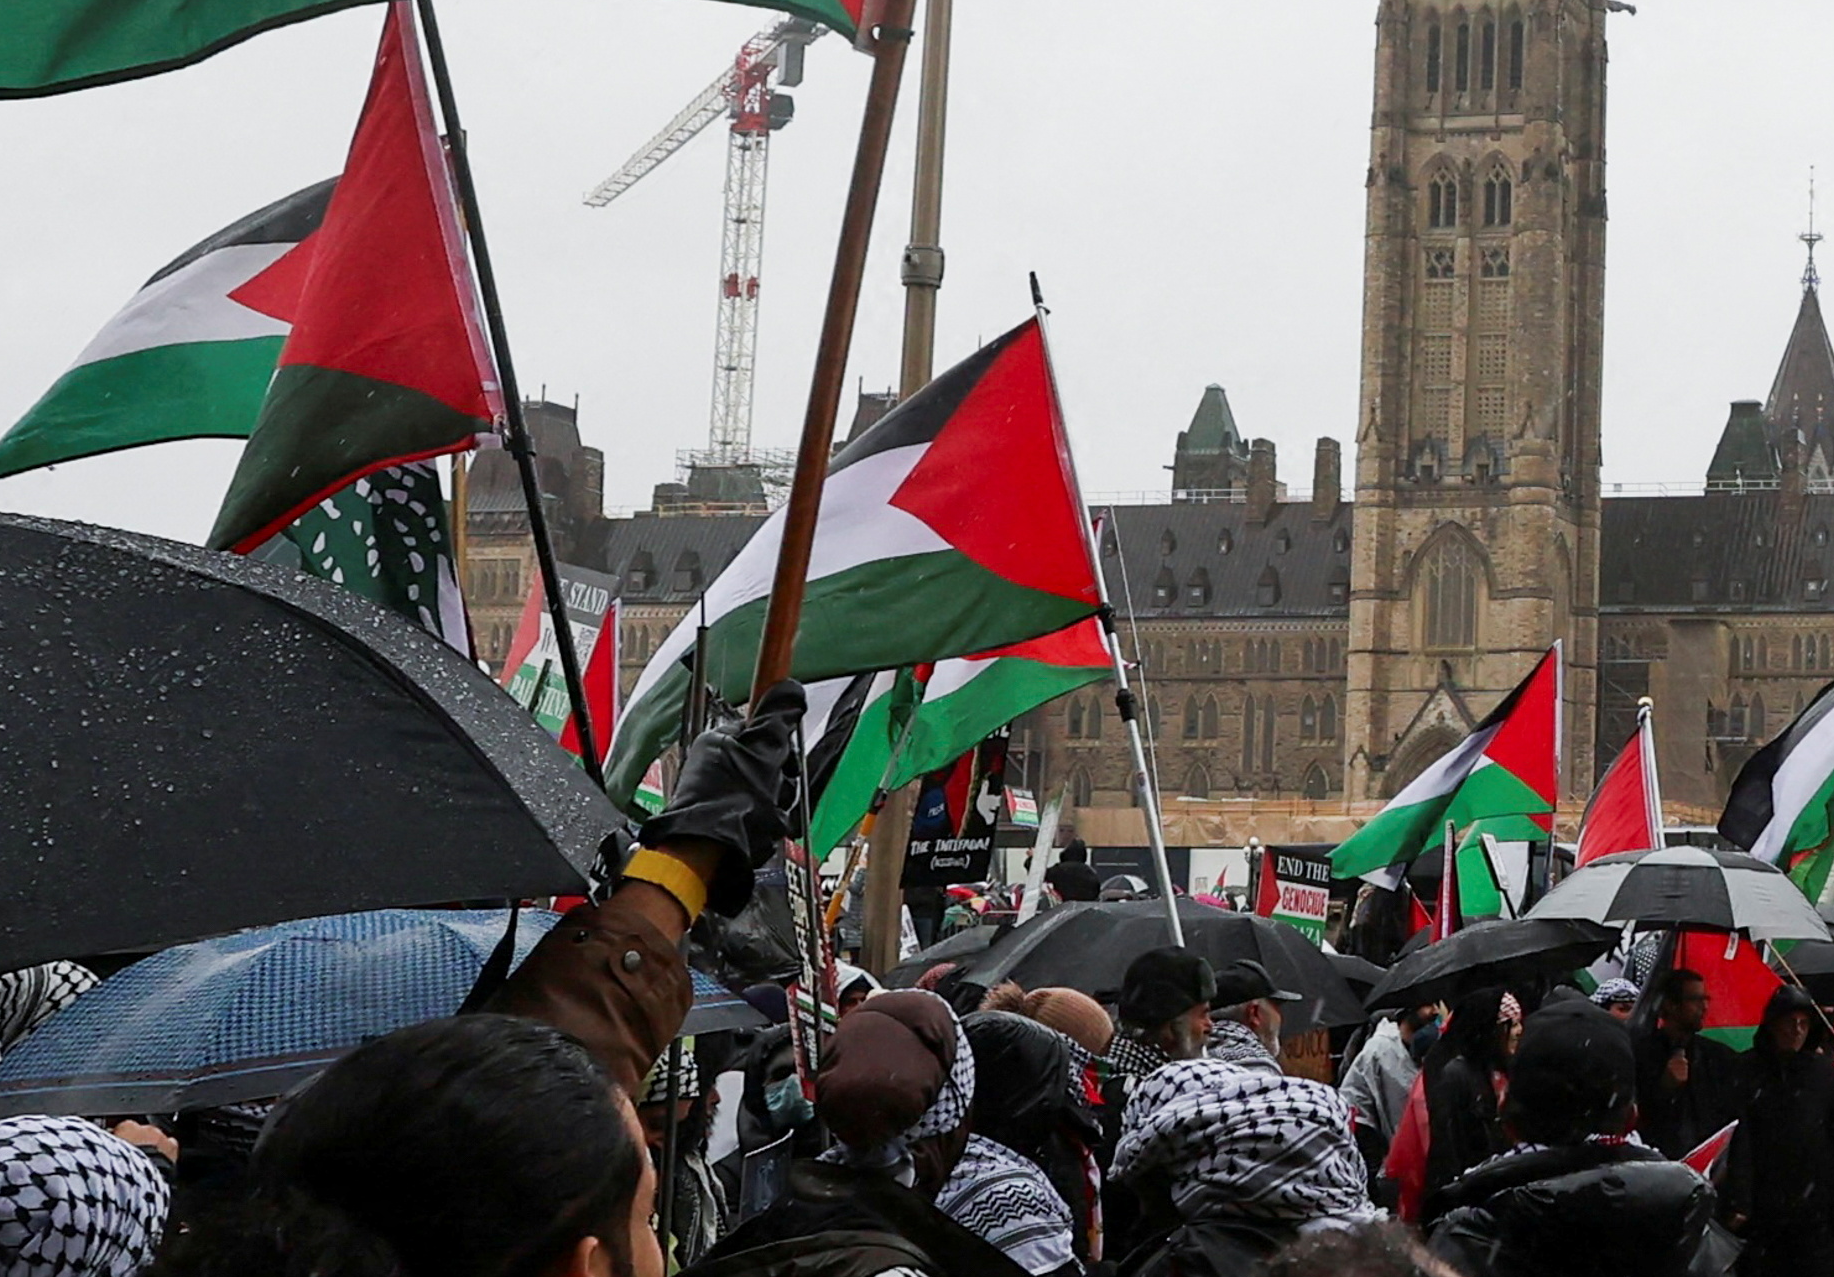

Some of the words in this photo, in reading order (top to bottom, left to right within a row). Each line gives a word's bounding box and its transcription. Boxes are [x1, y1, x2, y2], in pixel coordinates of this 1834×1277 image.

[567, 582, 609, 616] STAND
[910, 840, 930, 856] THE
[1277, 856, 1303, 876] END
[1306, 862, 1330, 882] THE
[1282, 885, 1326, 917] GENOCIDE
